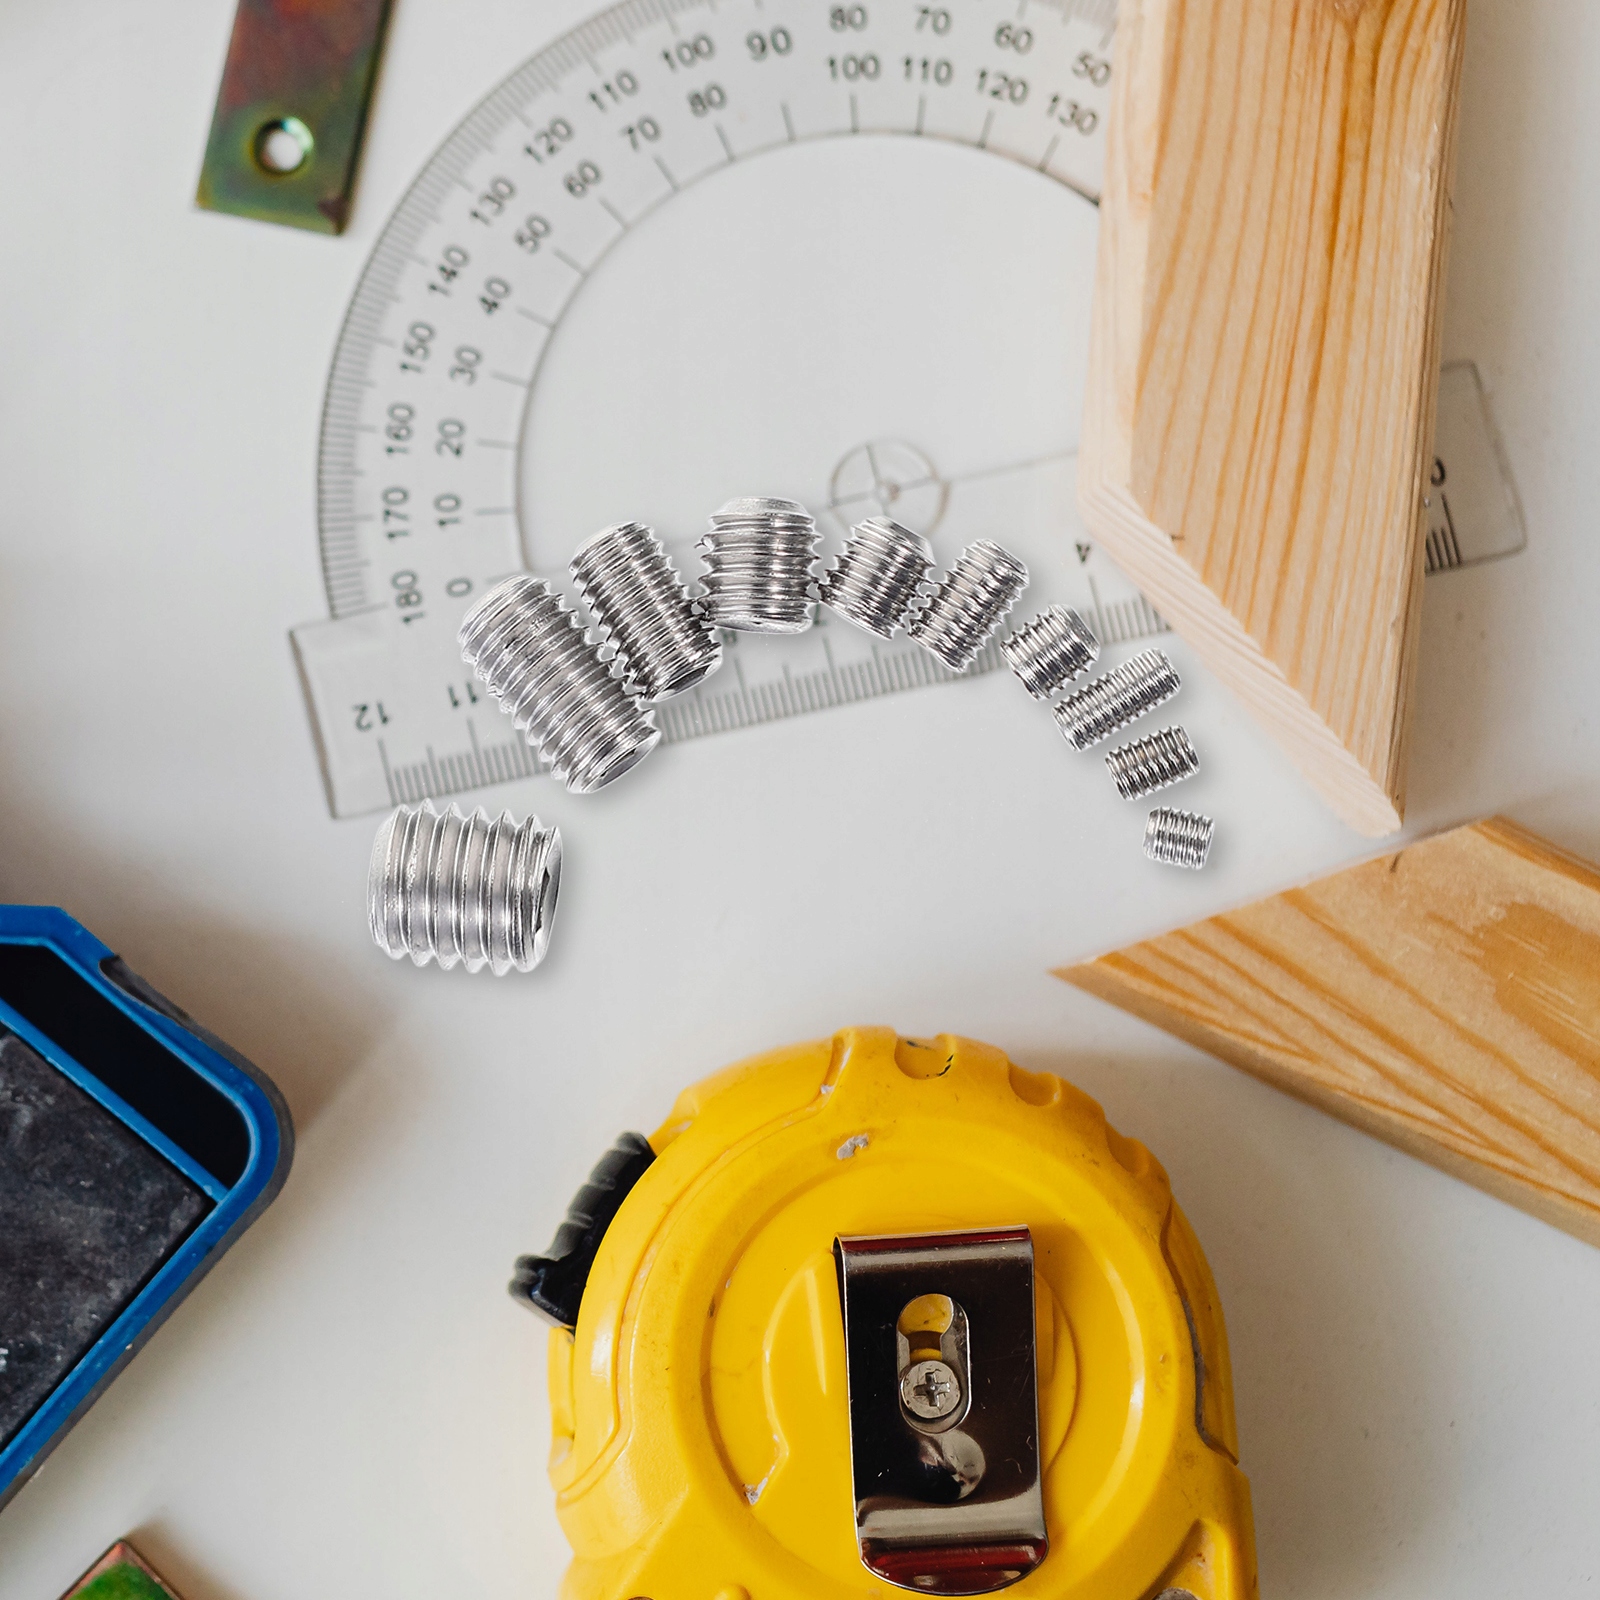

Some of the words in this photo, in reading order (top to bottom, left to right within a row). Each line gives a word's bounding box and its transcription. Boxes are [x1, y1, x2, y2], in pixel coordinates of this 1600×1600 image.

[829, 3, 868, 33] 80
[915, 5, 952, 36] 70
[661, 34, 716, 72] 100
[747, 26, 793, 61] 90
[993, 21, 1034, 55] 60
[827, 54, 881, 81] 100
[902, 55, 954, 86] 110
[1072, 51, 1112, 87] 50
[588, 70, 640, 112] 110
[687, 82, 728, 118] 80
[977, 68, 1029, 106] 120
[621, 115, 662, 152] 70
[1047, 93, 1098, 136] 130
[524, 116, 575, 164] 120
[563, 159, 602, 199] 60
[469, 177, 517, 225] 130
[514, 214, 553, 254] 50
[427, 244, 470, 297] 140
[478, 276, 512, 316] 40
[399, 321, 436, 374] 150
[449, 345, 483, 386] 30
[385, 402, 416, 457] 160
[435, 418, 466, 458] 20
[382, 485, 410, 542] 170
[433, 492, 462, 529] 10
[390, 569, 425, 626] 180
[445, 577, 474, 598] 0
[447, 680, 478, 710] 11
[354, 701, 389, 732] 12
